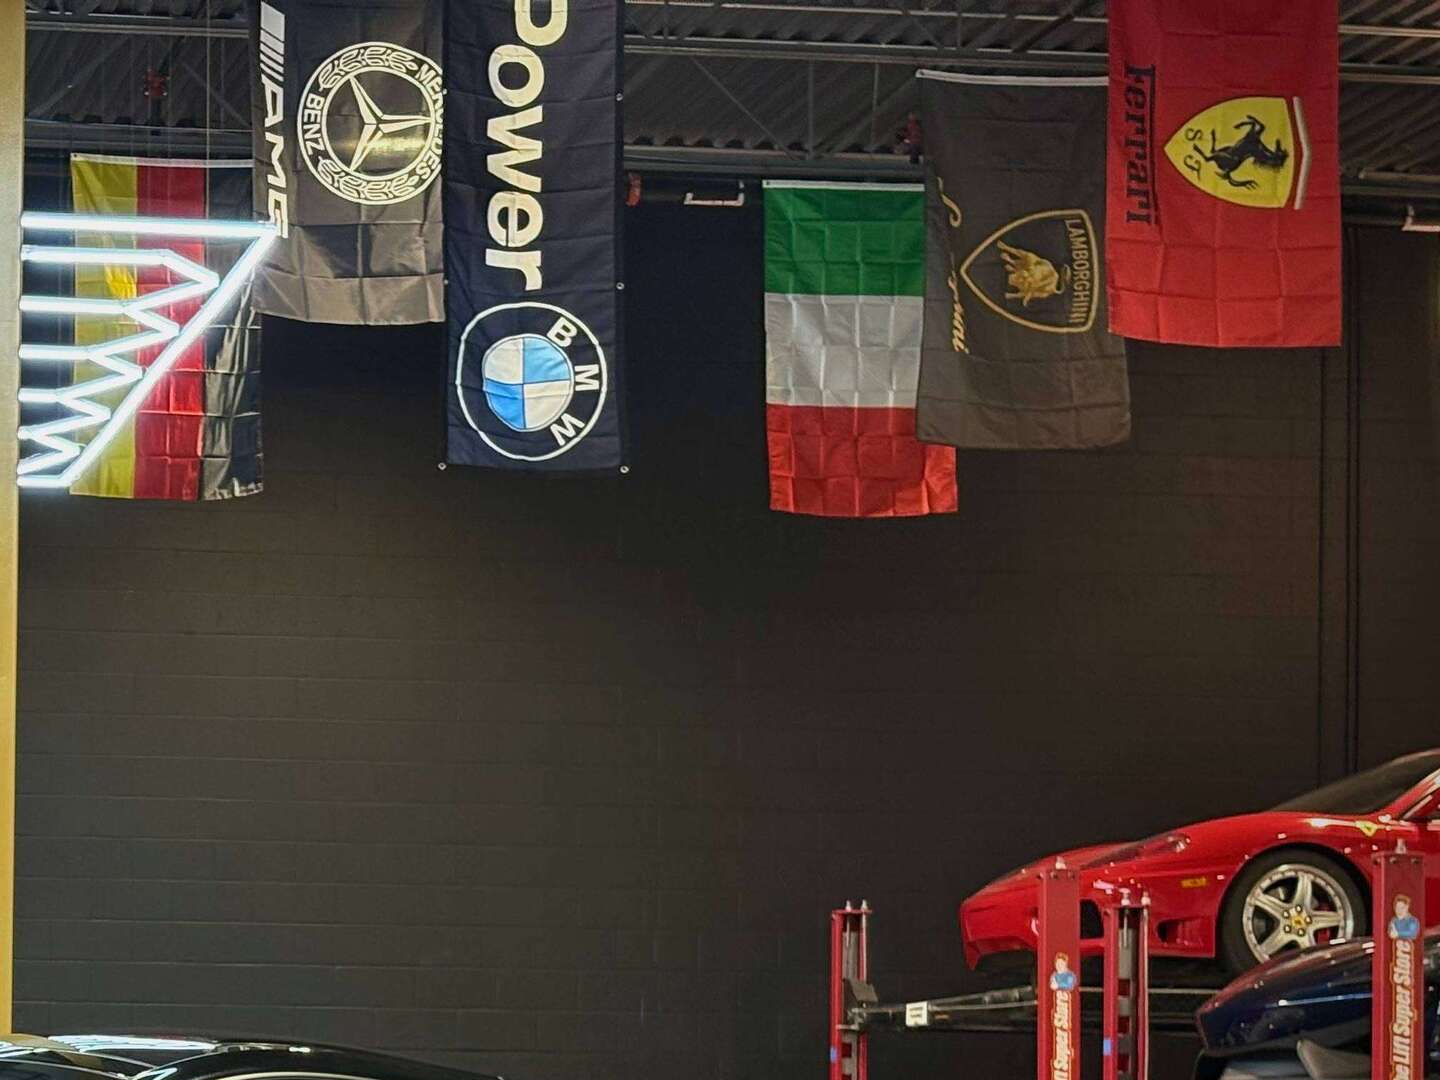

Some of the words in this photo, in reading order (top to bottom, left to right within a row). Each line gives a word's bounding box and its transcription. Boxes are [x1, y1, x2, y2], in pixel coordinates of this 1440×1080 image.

[303, 92, 326, 156] BENZ
[1124, 63, 1158, 225] Ferrari
[1064, 218, 1091, 323] LAMBORGHINI
[546, 316, 601, 447] BMW
[1393, 939, 1411, 986] Store
[1392, 986, 1415, 1036] Super
